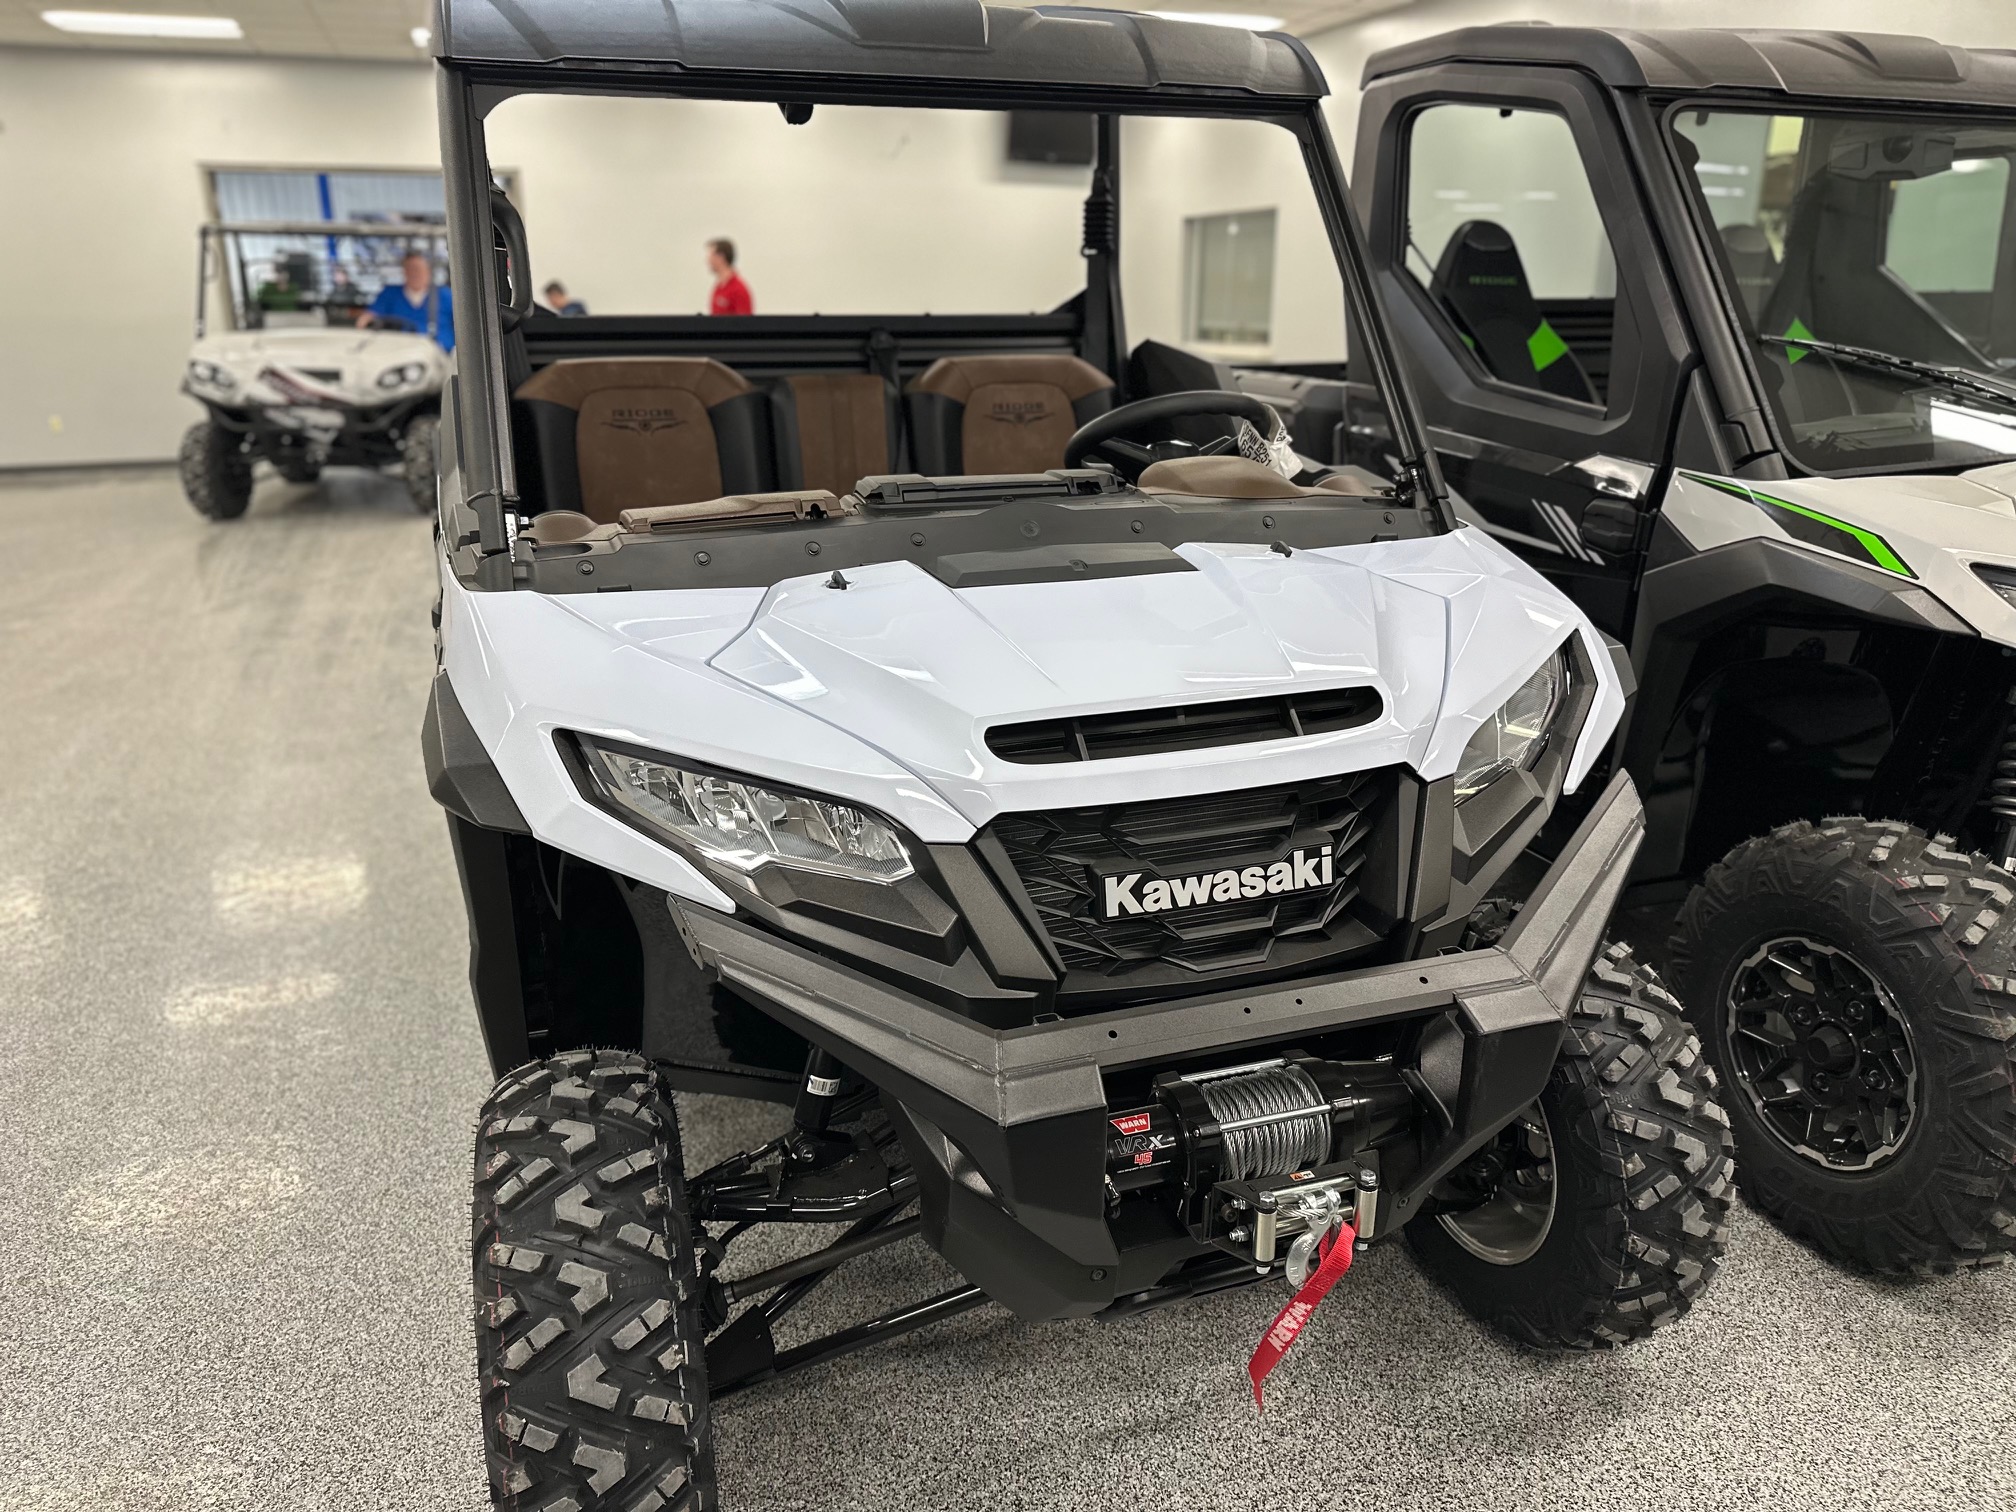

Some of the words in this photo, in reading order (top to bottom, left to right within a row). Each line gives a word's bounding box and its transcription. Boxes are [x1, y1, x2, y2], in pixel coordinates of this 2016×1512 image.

[1104, 845, 1333, 918] Kawasaki
[1119, 1118, 1147, 1130] WARN
[1134, 1151, 1153, 1166] 45
[1267, 1301, 1313, 1353] WARN
